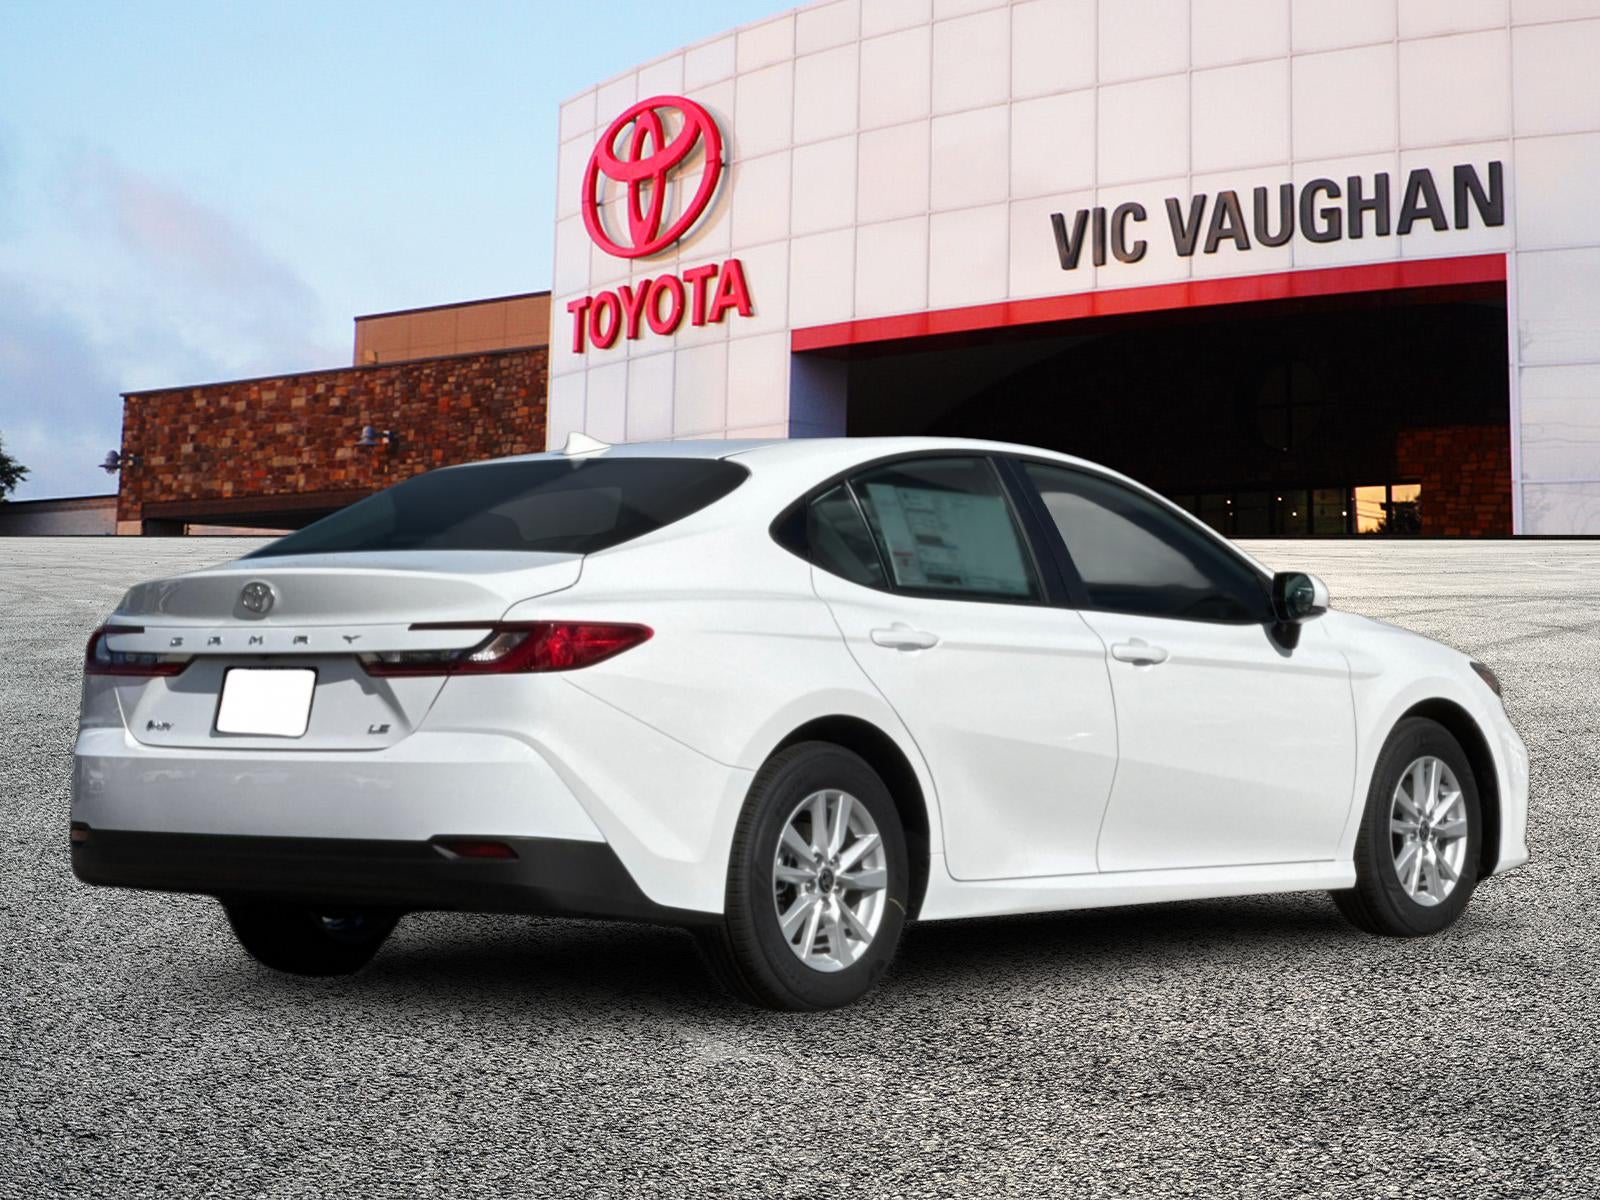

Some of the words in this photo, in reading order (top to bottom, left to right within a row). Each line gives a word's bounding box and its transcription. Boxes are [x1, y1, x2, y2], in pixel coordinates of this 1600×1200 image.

[1050, 201, 1147, 270] VIC
[1165, 161, 1504, 258] VAUGHAN
[567, 259, 753, 353] TOYOTA
